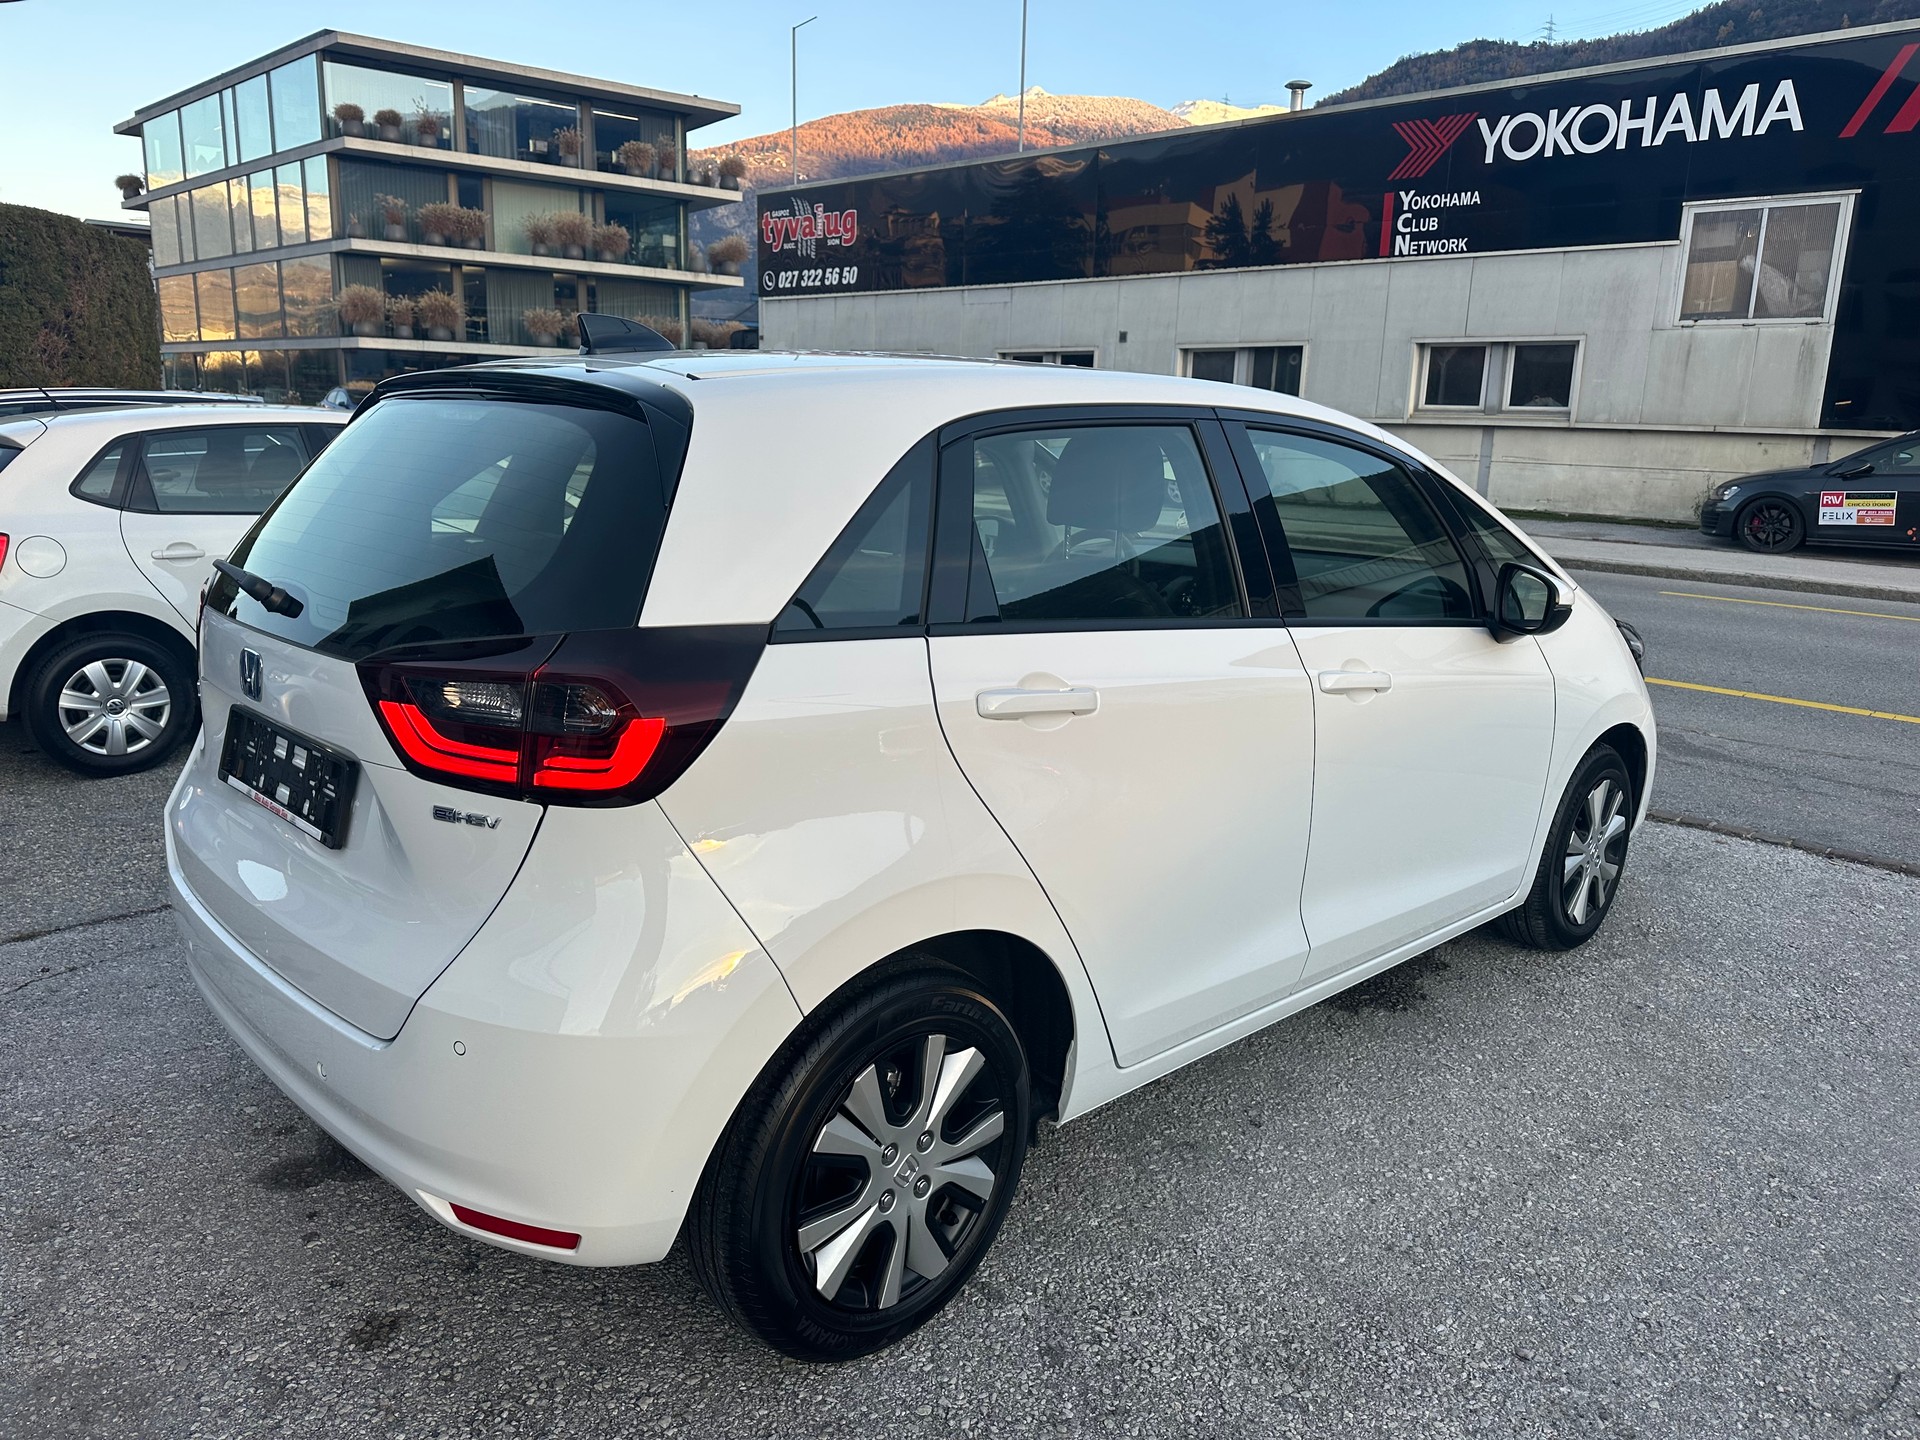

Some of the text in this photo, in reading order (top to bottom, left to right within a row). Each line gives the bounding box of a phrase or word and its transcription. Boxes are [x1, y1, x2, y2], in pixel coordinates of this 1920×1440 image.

[1477, 79, 1804, 164] YOKOHAMA
[1399, 190, 1481, 210] YOKOHAMA
[1397, 213, 1439, 233] CLUB
[1394, 235, 1468, 256] NETWORK
[778, 266, 858, 288] 027 322 56 50
[1822, 511, 1853, 520] FELIX
